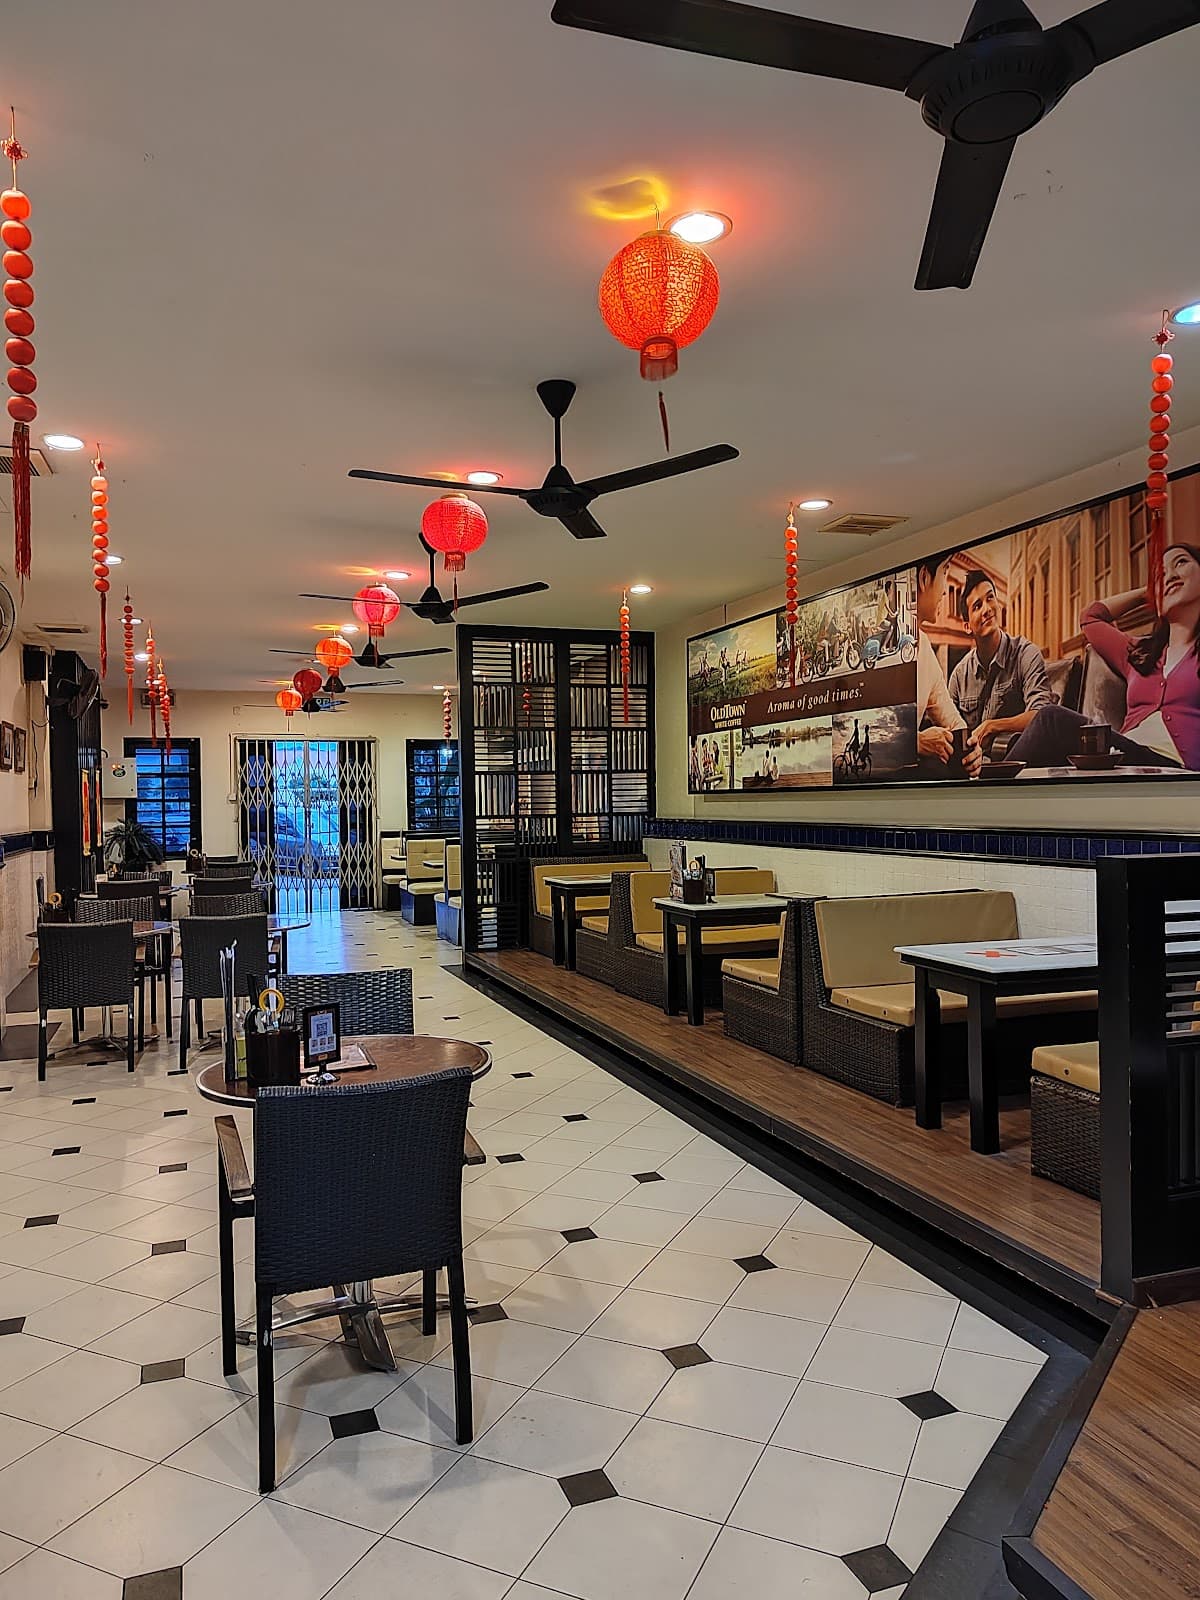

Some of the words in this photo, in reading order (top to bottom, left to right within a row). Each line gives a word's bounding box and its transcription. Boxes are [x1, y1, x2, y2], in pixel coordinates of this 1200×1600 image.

[767, 699, 795, 713] Aroma
[797, 694, 808, 711] of
[808, 690, 830, 710] good
